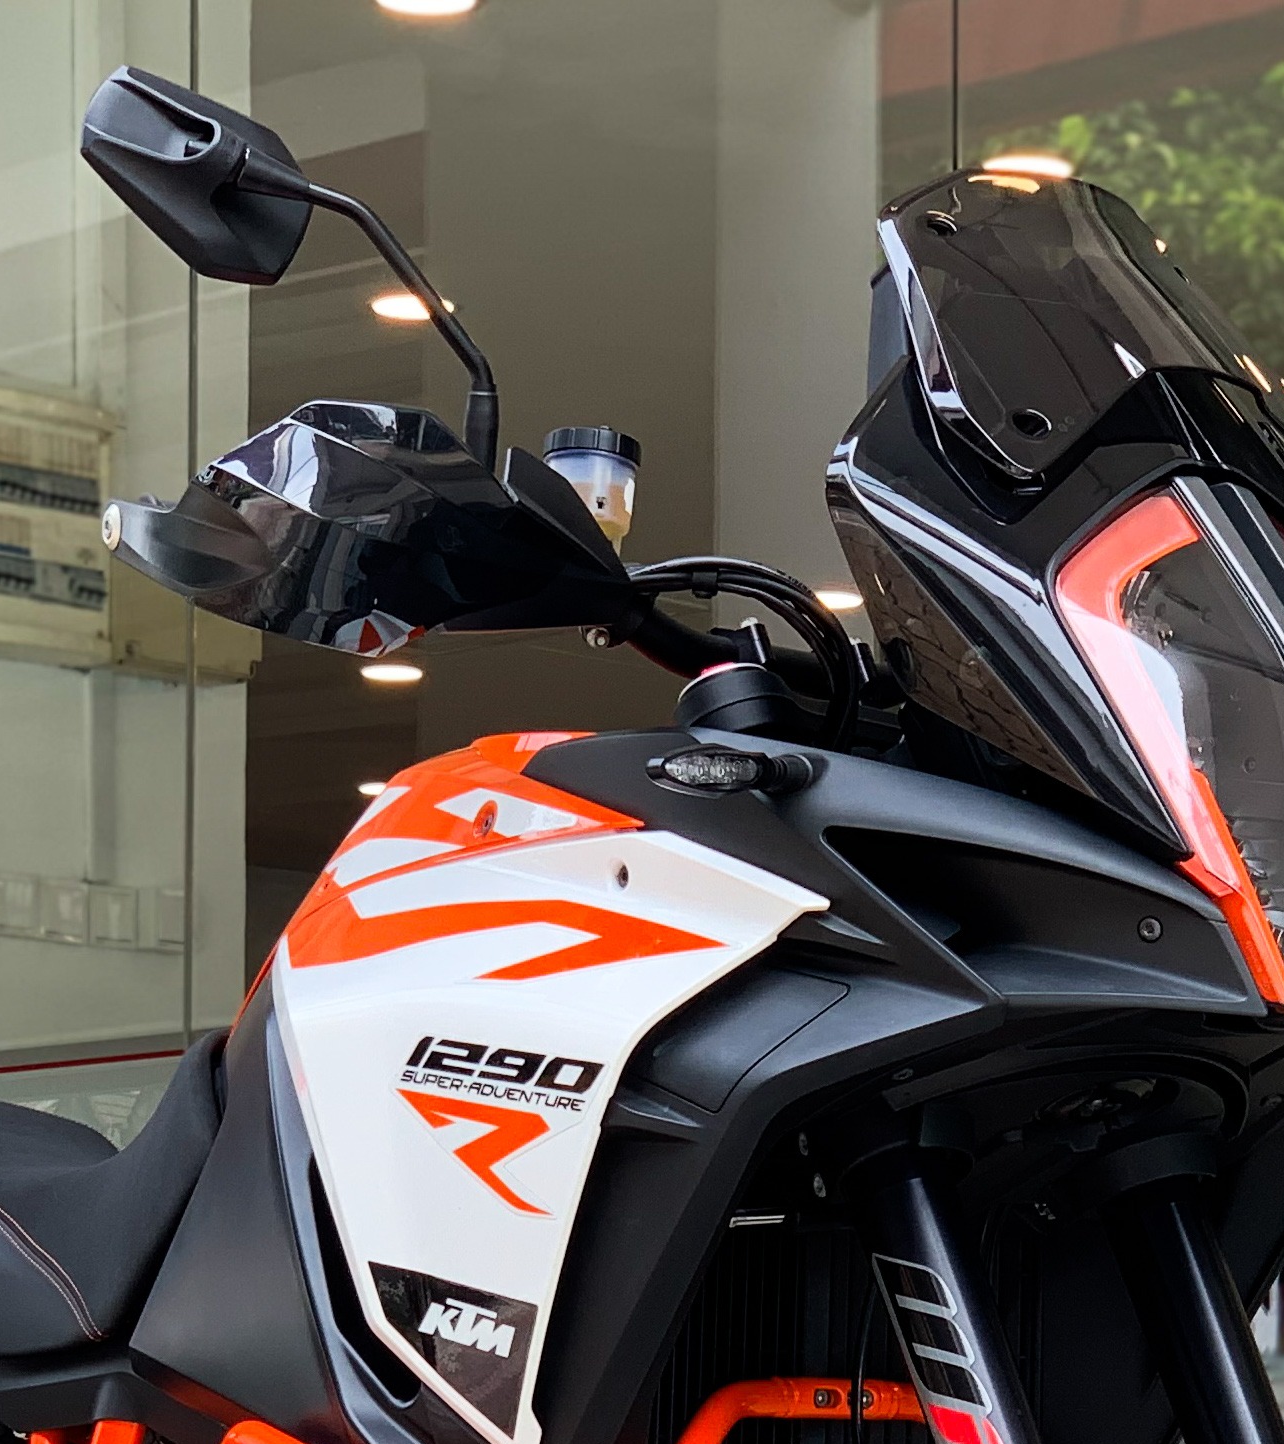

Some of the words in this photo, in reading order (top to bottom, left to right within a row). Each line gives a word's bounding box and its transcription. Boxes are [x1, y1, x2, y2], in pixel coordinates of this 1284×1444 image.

[400, 1069, 586, 1112] SUPER-ADVENTURE
[405, 1035, 605, 1095] 1290
[417, 1297, 516, 1358] KTM
